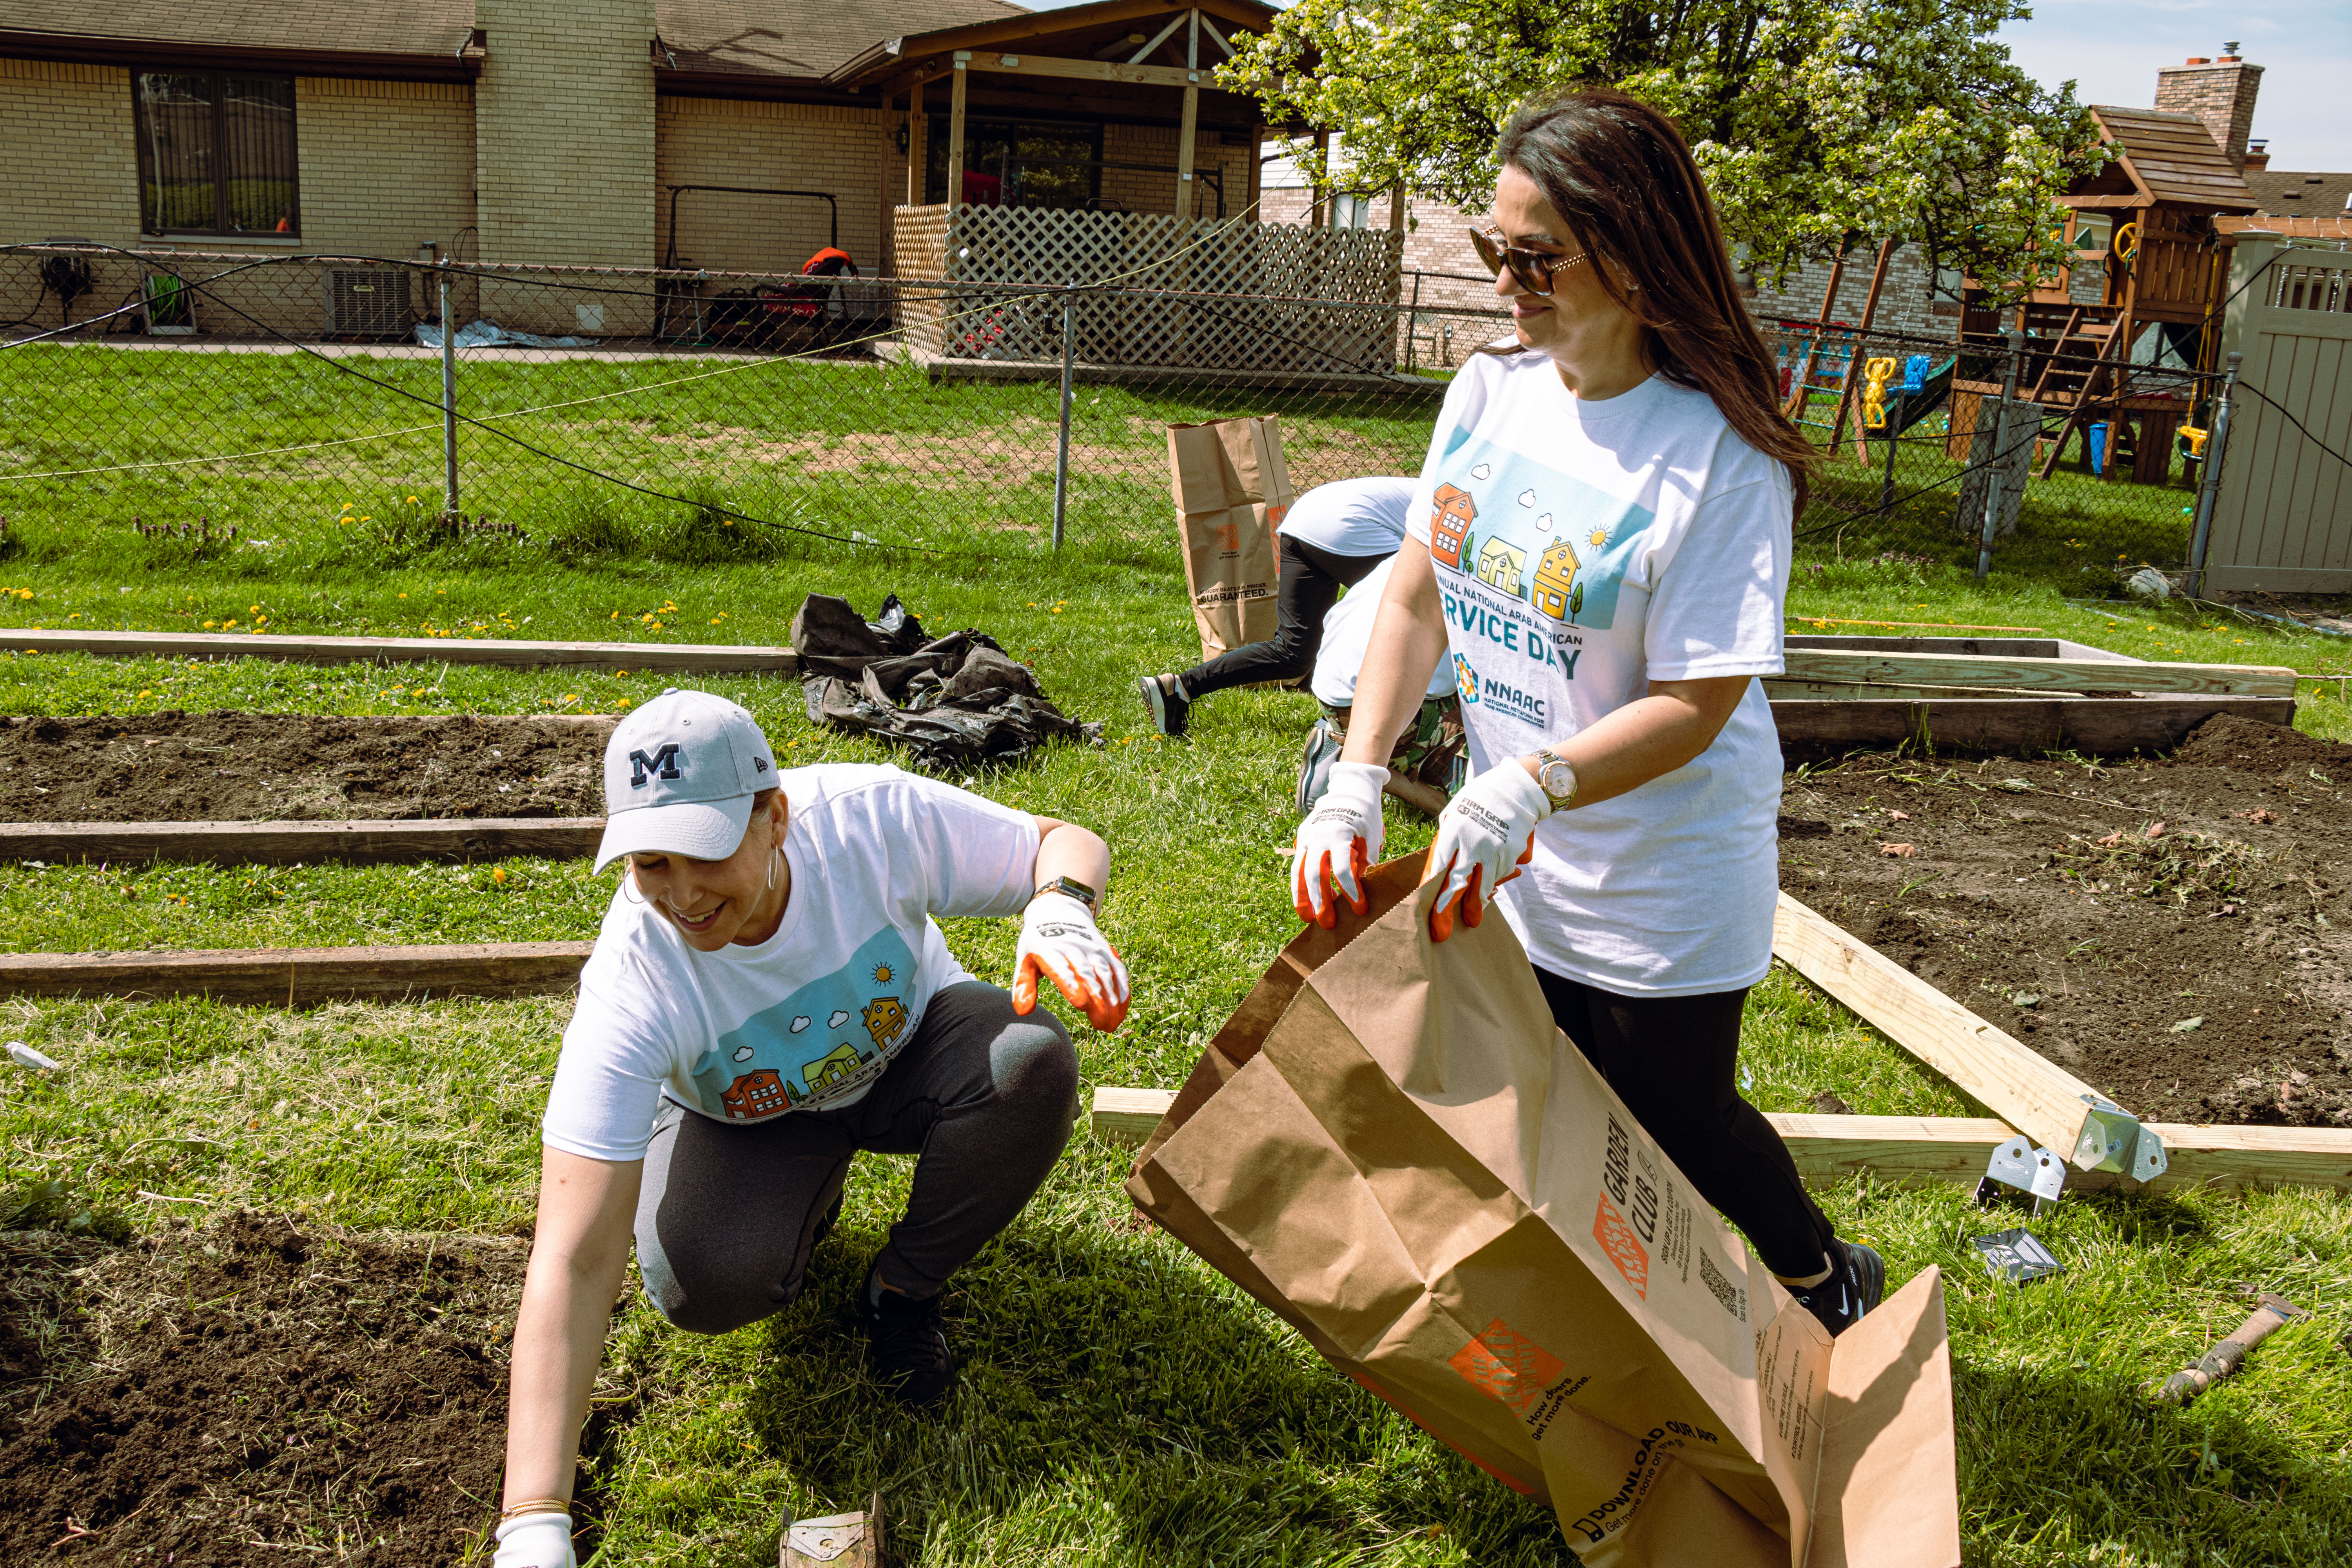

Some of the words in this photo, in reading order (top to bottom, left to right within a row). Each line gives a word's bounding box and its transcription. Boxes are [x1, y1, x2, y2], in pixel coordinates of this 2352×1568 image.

[1201, 588, 1269, 603] GUARANTEED.
[1464, 587, 1507, 615] NATIONAL
[1509, 609, 1532, 626] ARAB
[1534, 621, 1583, 645] AMERICAN
[1439, 588, 1519, 652] RVICE
[1528, 630, 1582, 680] DAY
[1484, 697, 1509, 710] NATIONAL
[1510, 706, 1533, 719] NETWORK
[1485, 678, 1545, 716] NNAAC
[1495, 707, 1517, 717] AMERICAN
[1517, 715, 1544, 729] COMMUNITIES
[630, 743, 681, 787] M
[1337, 808, 1363, 817] GRIP
[1458, 805, 1470, 815] A1
[1461, 798, 1485, 814] FIRM
[1485, 811, 1510, 830] GRIP
[855, 1061, 881, 1080] ARAB
[884, 1014, 920, 1061] AMERICAN
[1604, 1111, 1629, 1206] GARDEN
[1632, 1175, 1658, 1243] CLUB
[1667, 1207, 1673, 1215] A
[1599, 1197, 1646, 1292] HOME
[1664, 1231, 1671, 1245] UP
[1472, 1352, 1490, 1385] THE
[1485, 1325, 1524, 1414] HOME
[1517, 1341, 1538, 1397] DEPOT
[1526, 1401, 1548, 1425] How
[1545, 1377, 1572, 1400] doers
[1531, 1423, 1548, 1441] get
[1544, 1394, 1565, 1422] more
[1564, 1376, 1592, 1397] done.
[1588, 1427, 1665, 1520] DOWNLOAD
[1665, 1421, 1696, 1438] OUR
[1695, 1426, 1718, 1445] APP
[1605, 1518, 1624, 1532] Get
[1621, 1497, 1642, 1524] more
[1639, 1468, 1655, 1496] done
[1652, 1451, 1664, 1466] on
[1658, 1439, 1675, 1450] the
[1674, 1439, 1685, 1448] go
